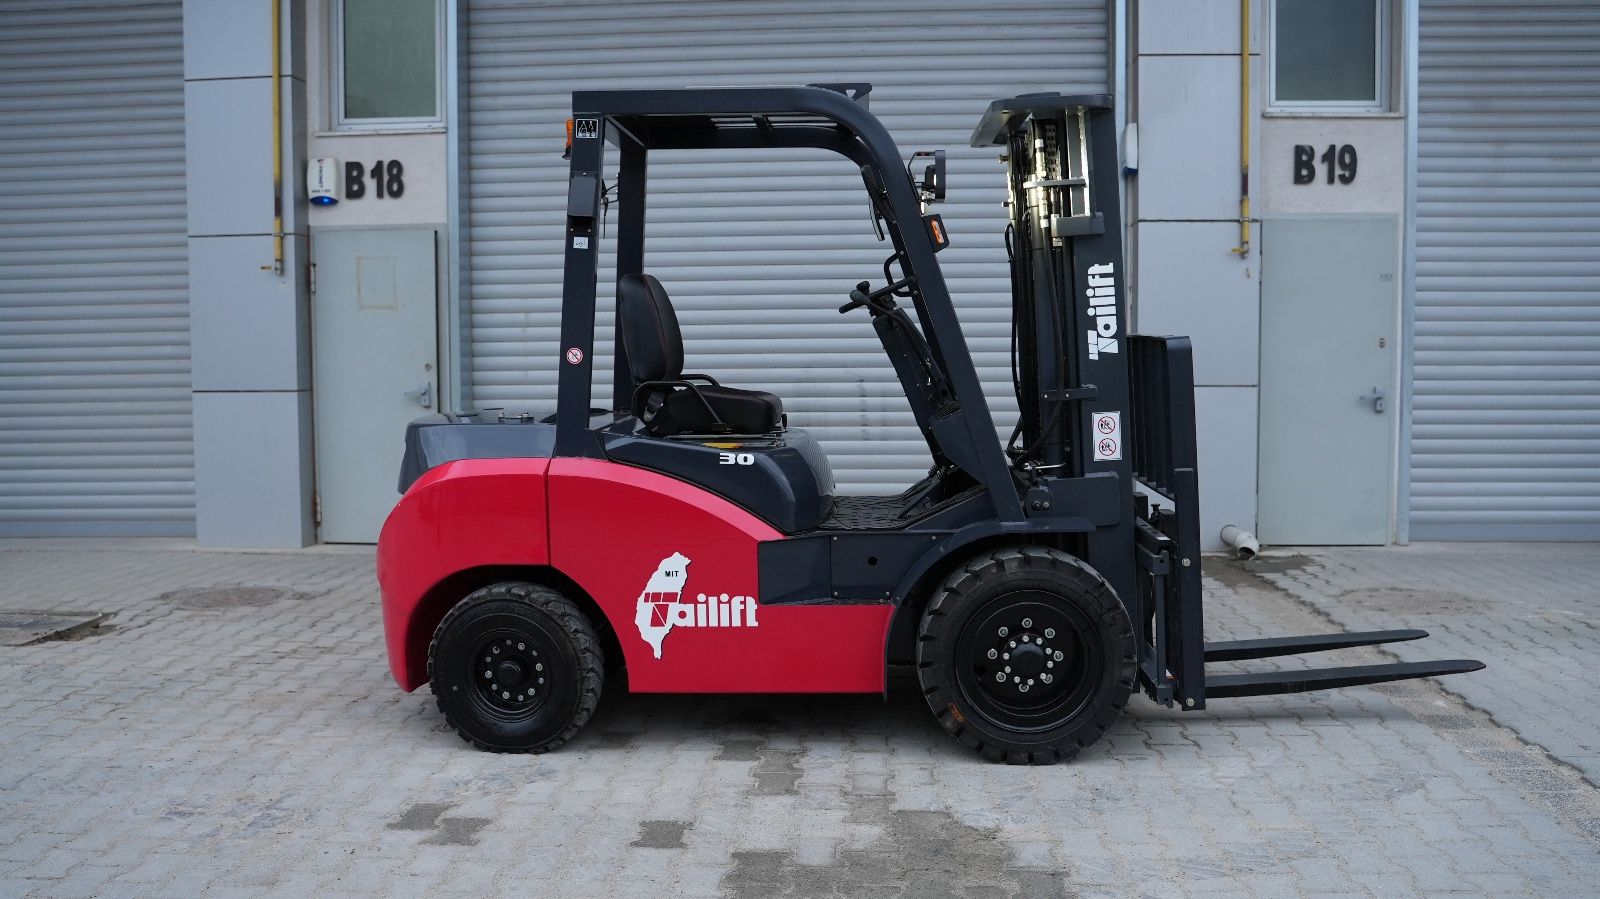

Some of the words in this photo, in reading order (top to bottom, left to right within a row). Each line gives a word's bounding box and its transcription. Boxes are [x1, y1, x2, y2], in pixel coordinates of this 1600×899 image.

[1085, 262, 1119, 361] Tailift
[719, 452, 755, 466] 30
[664, 570, 679, 578] MIT
[643, 592, 759, 628] Tailift
